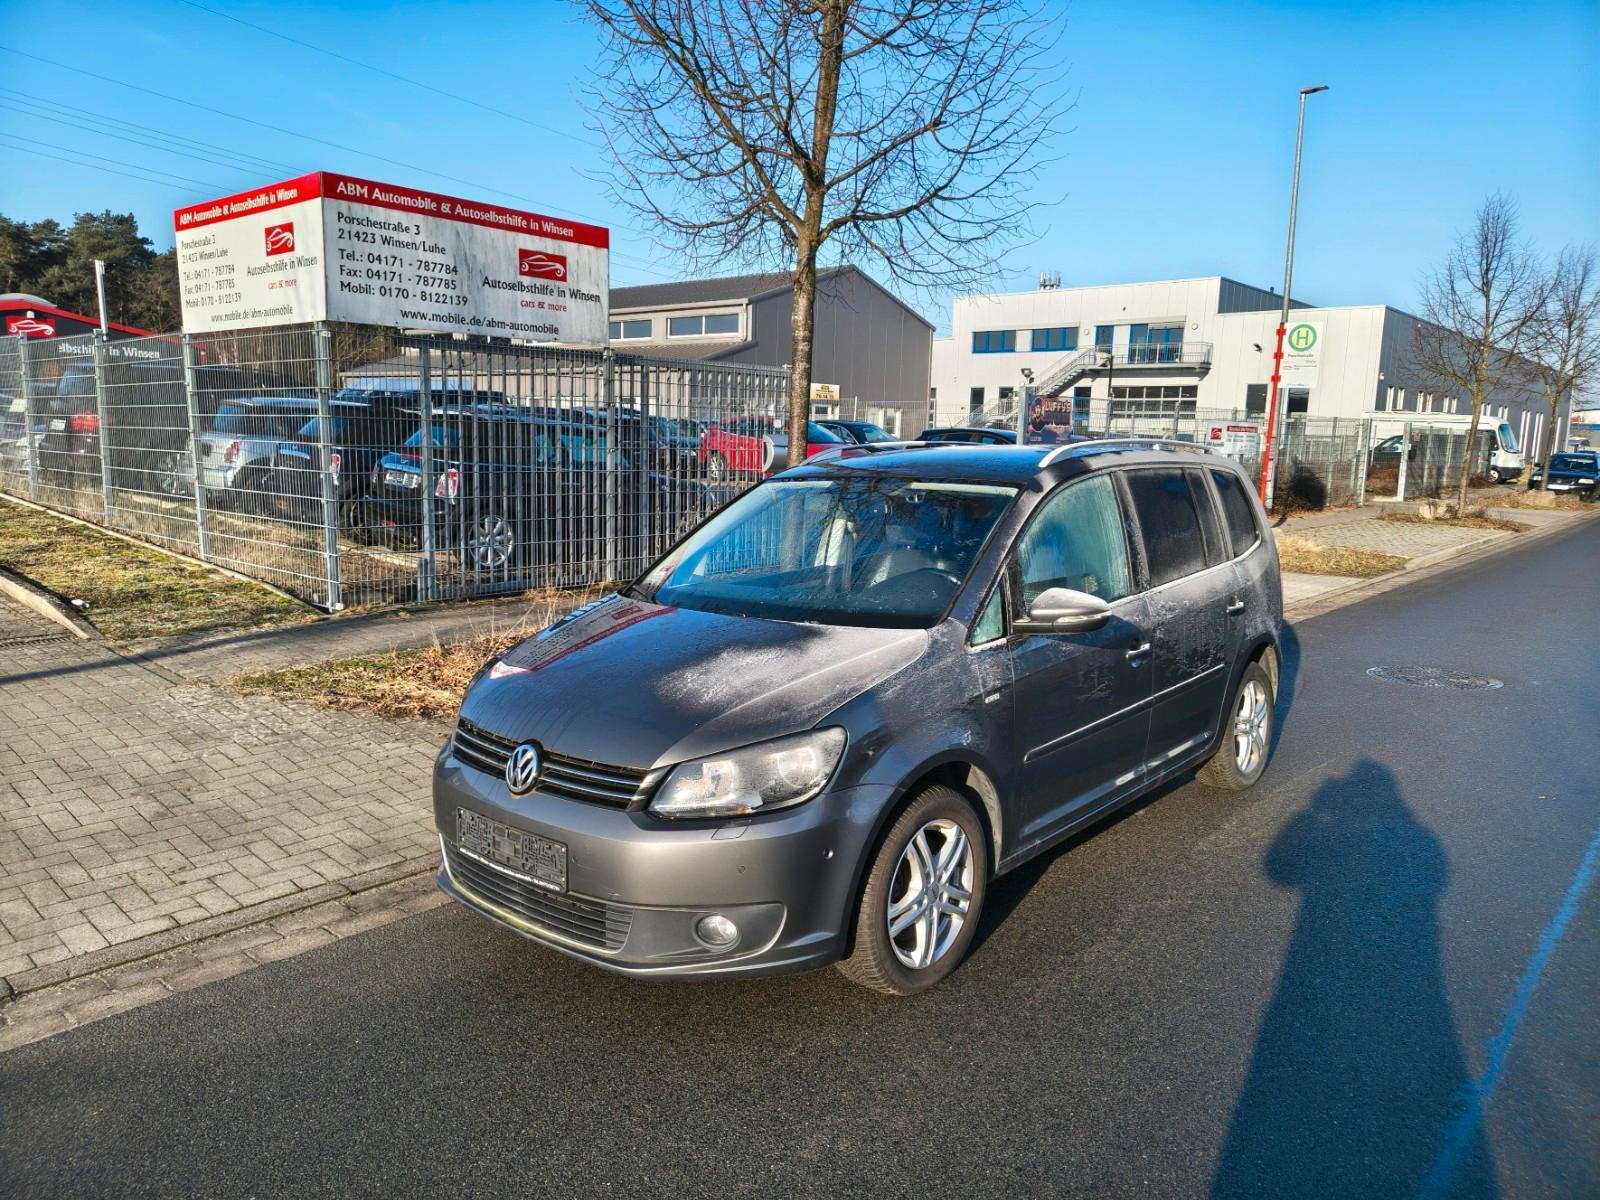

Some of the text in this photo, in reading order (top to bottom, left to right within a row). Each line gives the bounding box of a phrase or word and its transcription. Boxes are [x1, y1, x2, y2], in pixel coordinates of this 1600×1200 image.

[180, 188, 298, 225] ABM Automobile & Autoselbsthilfe in Winsen
[337, 181, 574, 237] ABM Automobile & Autoselbsthilfe in Winsen
[337, 212, 420, 235] Porschestraße 3
[212, 234, 216, 244] 3
[338, 228, 446, 254] 21423 Winsen/Luhe
[182, 248, 228, 264] 21423 Winsen/Luhe
[248, 256, 318, 276] Autoselbsthilfe in Winsen
[338, 248, 363, 262] Tel.:
[367, 252, 403, 268] 04171
[416, 260, 458, 275] 787784
[194, 268, 210, 280] 04171
[285, 279, 296, 287] more
[340, 265, 362, 278] Fax:
[366, 268, 402, 283] 04171
[416, 275, 456, 290] 787785
[195, 282, 210, 294] 04171
[340, 281, 375, 296] Mobil:
[379, 286, 409, 300] 0170
[420, 291, 468, 306] 8122139
[482, 276, 600, 303] Autoselbsthilfe in Winsen
[521, 300, 535, 308] cars
[548, 303, 567, 312] more
[400, 310, 559, 335] www.mobile.de/abm-automobile
[1296, 330, 1309, 346] H
[109, 346, 120, 356] in
[122, 346, 160, 358] Winsen
